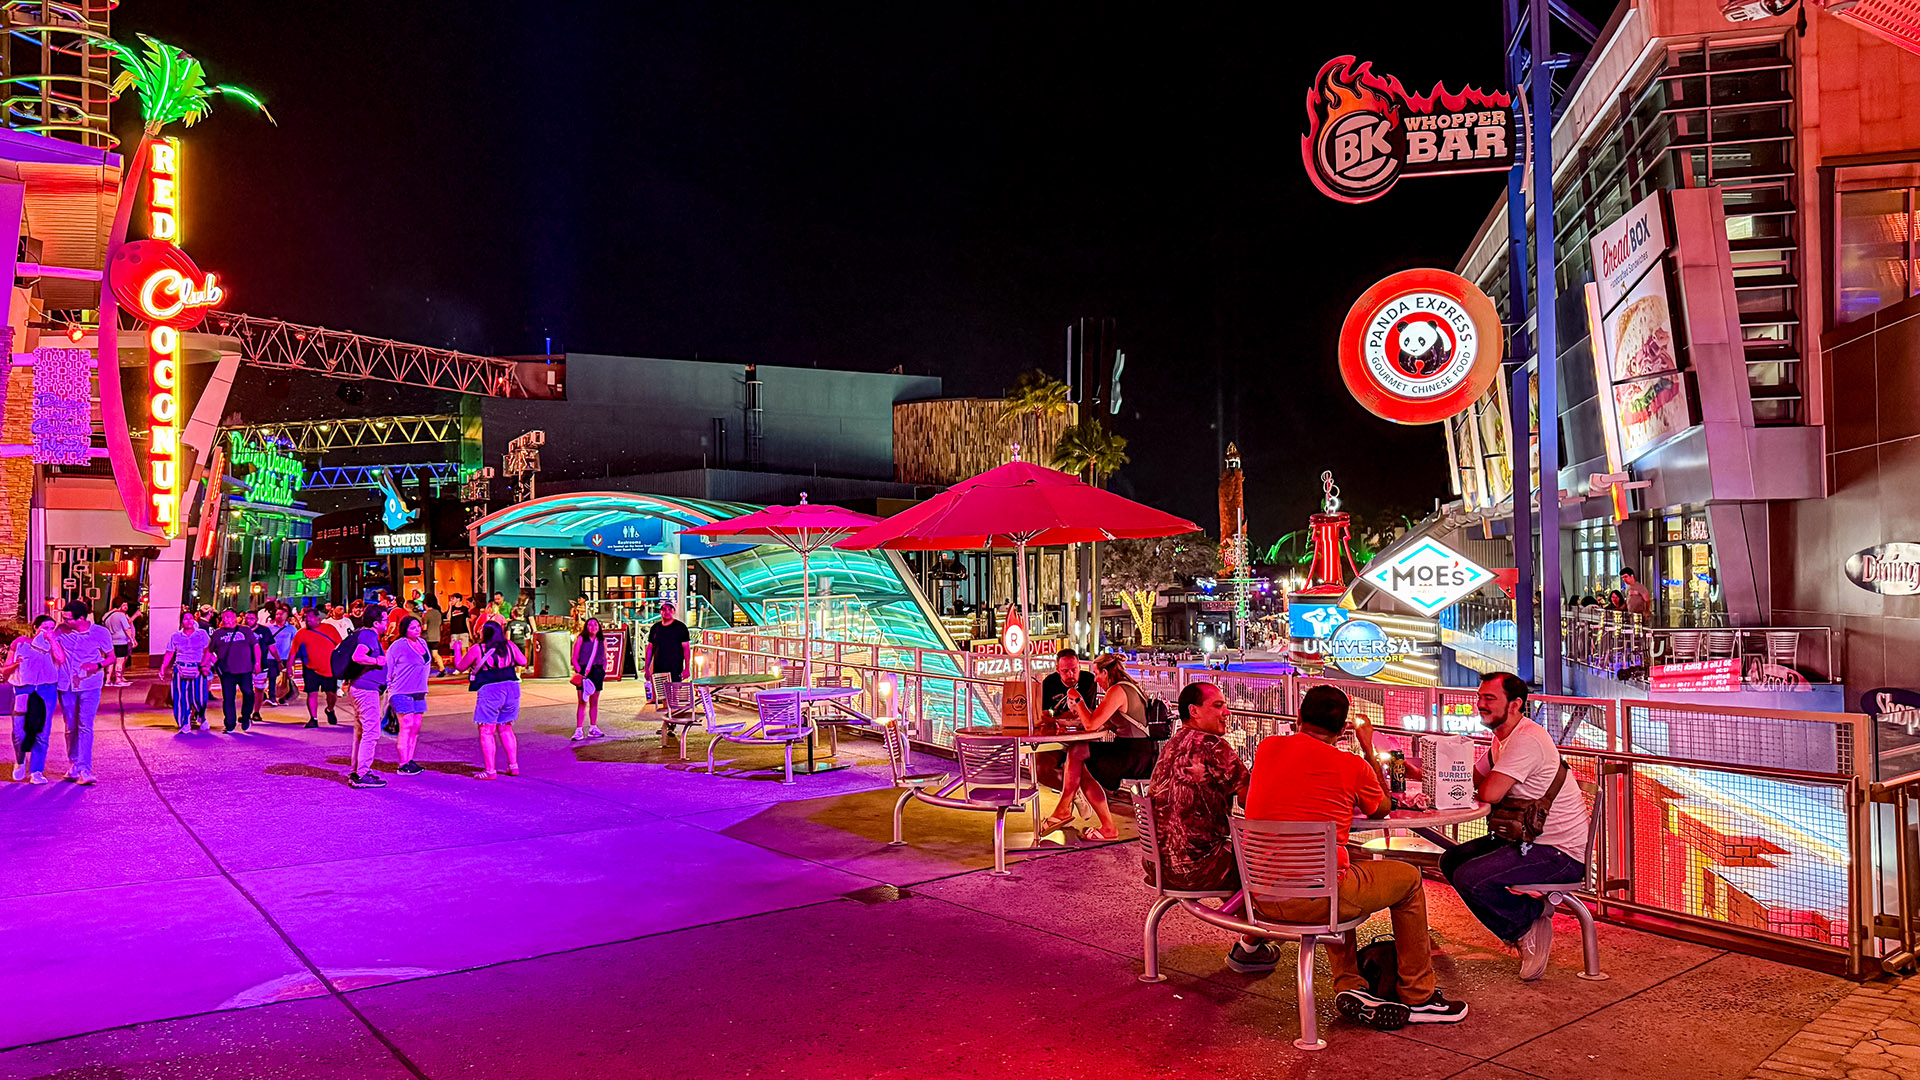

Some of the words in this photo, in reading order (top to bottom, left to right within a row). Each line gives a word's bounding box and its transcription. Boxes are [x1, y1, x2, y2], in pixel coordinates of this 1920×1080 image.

[1404, 110, 1506, 132] WHOPPER
[1335, 120, 1392, 173] BK
[1406, 126, 1508, 164] BAR
[151, 143, 176, 240] RED
[141, 269, 223, 320] Club
[1370, 301, 1410, 348] PANDA
[1416, 297, 1473, 342] EXPRESS
[1371, 356, 1408, 392] GOURMET
[1411, 375, 1453, 394] CHINESE
[1453, 351, 1471, 378] FOOD
[1862, 553, 1920, 591] Dining
[977, 643, 1004, 656] RED
[1010, 632, 1018, 647] R
[1303, 638, 1423, 655] UNIVERSAL
[977, 658, 1012, 676] PIZZA
[1324, 655, 1371, 664] STUDIOS
[1373, 654, 1405, 663] STORE
[1876, 692, 1920, 736] Shop
[1438, 771, 1472, 779] BURRITO
